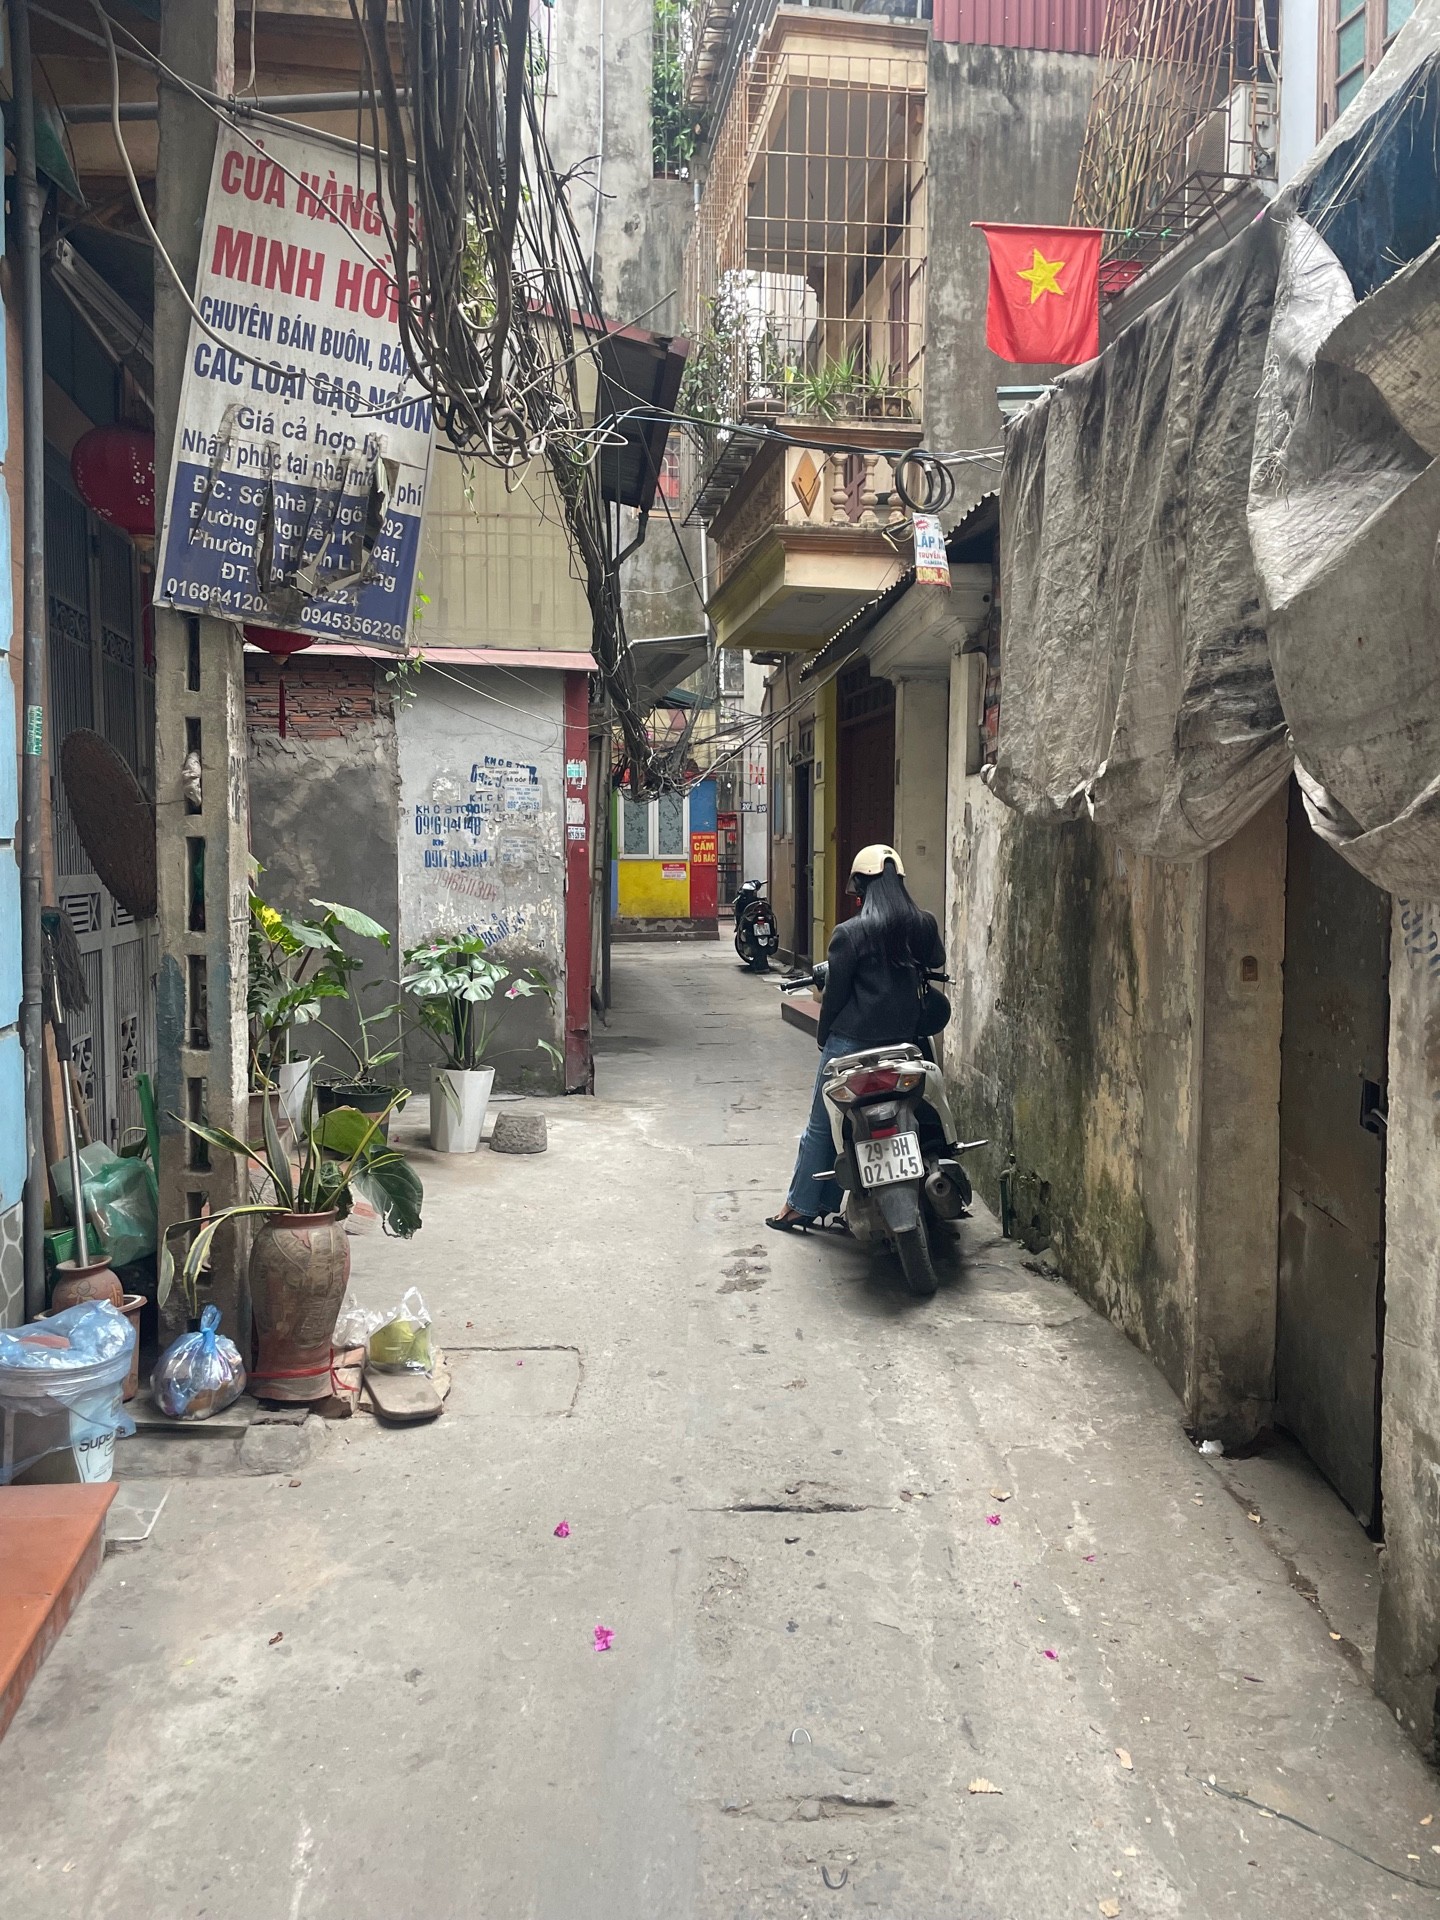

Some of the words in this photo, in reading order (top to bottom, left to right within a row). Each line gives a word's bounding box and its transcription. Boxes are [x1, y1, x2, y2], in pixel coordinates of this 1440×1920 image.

[221, 139, 285, 209] CỬA
[296, 170, 384, 237] HÀNG
[211, 225, 325, 301] MINH
[201, 296, 273, 341] CHUYÊN
[277, 315, 315, 352] BÁN
[321, 329, 373, 371] BUÔN,
[251, 356, 306, 405] LOẠI
[313, 372, 361, 416] GẠO
[367, 386, 432, 434] NGON
[237, 406, 275, 434] Giá
[282, 416, 307, 441] cả
[315, 423, 356, 456] hợp
[239, 486, 266, 507] Số
[274, 492, 307, 513] nhà
[287, 452, 309, 480] tại
[397, 483, 423, 507] phí
[221, 562, 252, 584] ĐT:
[301, 606, 402, 641] 0945356226
[693, 840, 715, 851] CẤM
[864, 1156, 919, 1184] 021.45
[865, 1136, 910, 1163] 29-BH
